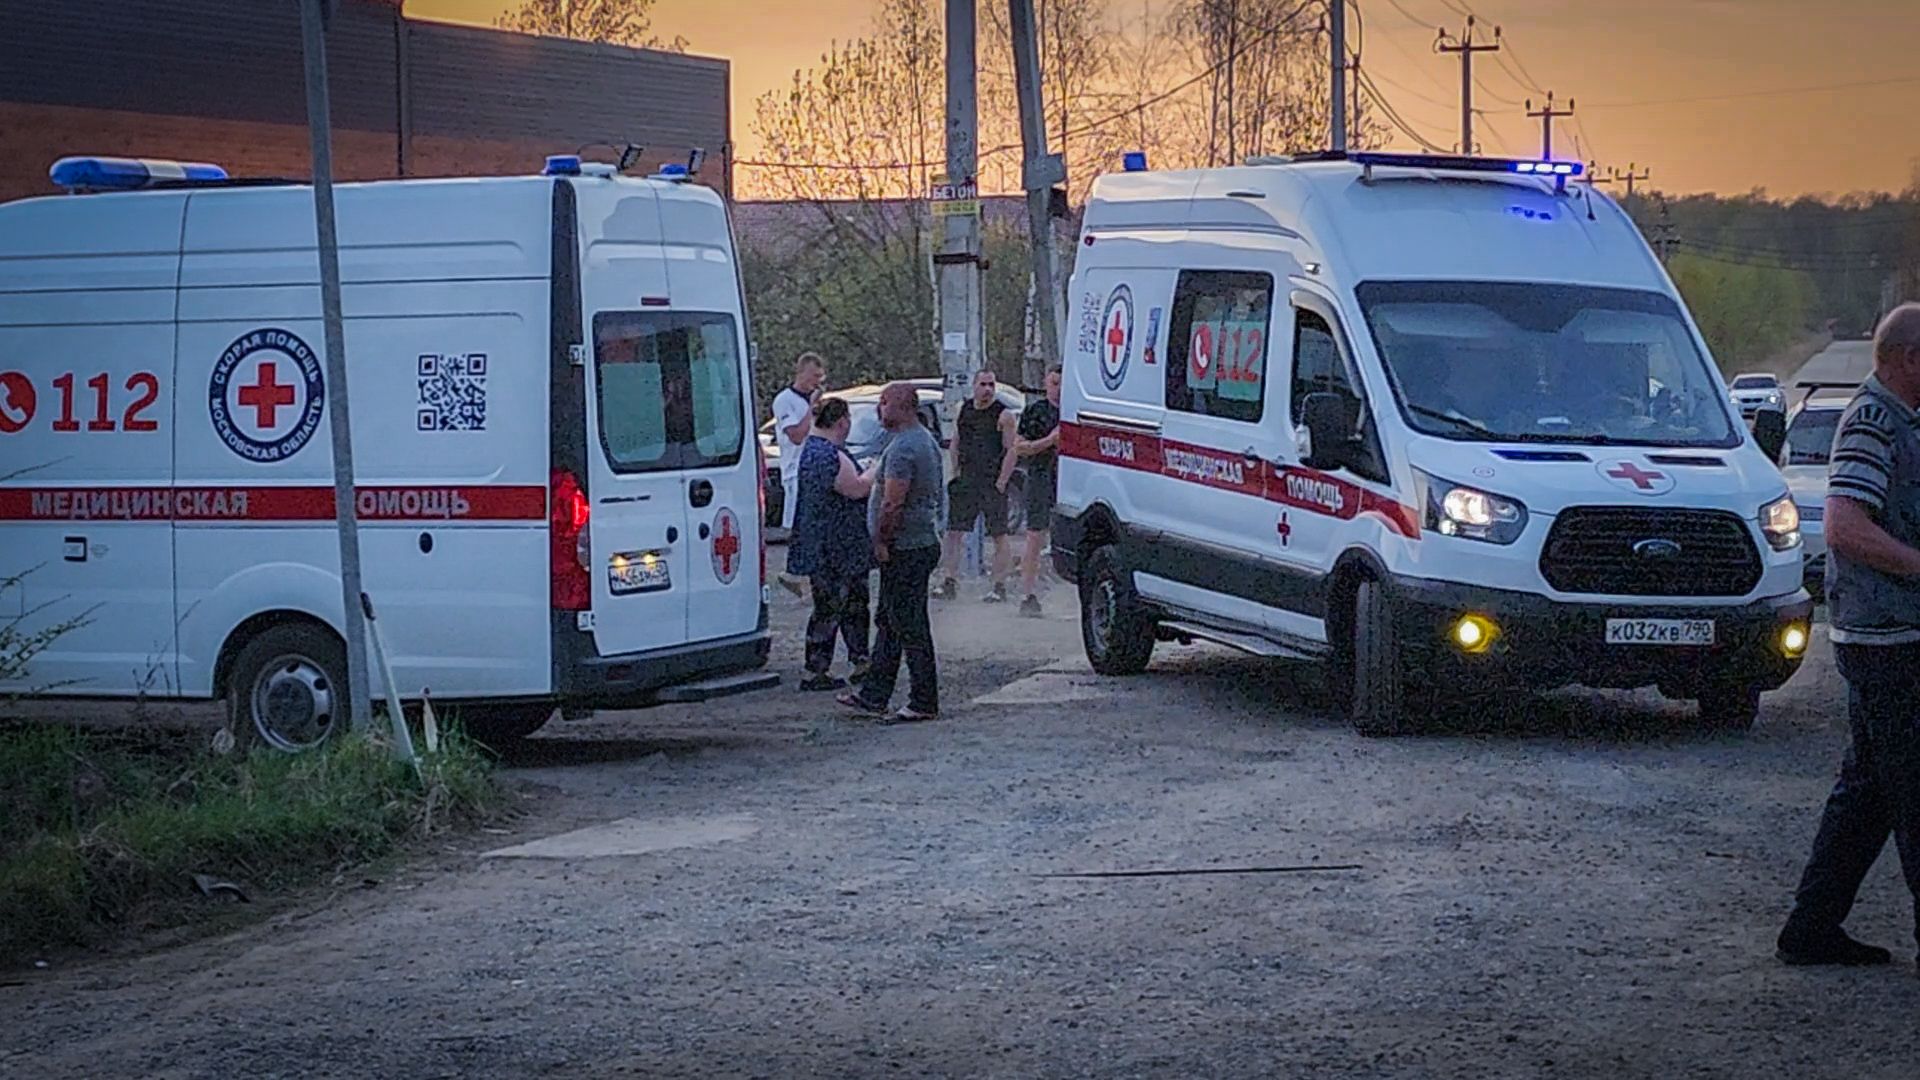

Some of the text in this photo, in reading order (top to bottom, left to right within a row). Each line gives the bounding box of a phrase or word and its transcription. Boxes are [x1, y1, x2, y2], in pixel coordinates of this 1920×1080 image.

[932, 183, 976, 200] БЕТОН
[215, 332, 319, 384] СКОРАЯ ПОМОЩЬ
[1216, 325, 1262, 382] 112
[53, 373, 158, 431] 112
[212, 396, 321, 459] МОСКОВСКАЯ ОБЛАСТЬ
[31, 490, 470, 519] МЕДИЦИНСКАЯ ОМОЩЬ
[1164, 448, 1245, 484] МЕДИЦИНСКАЯ
[1286, 475, 1344, 512] ПОМОЩЬ
